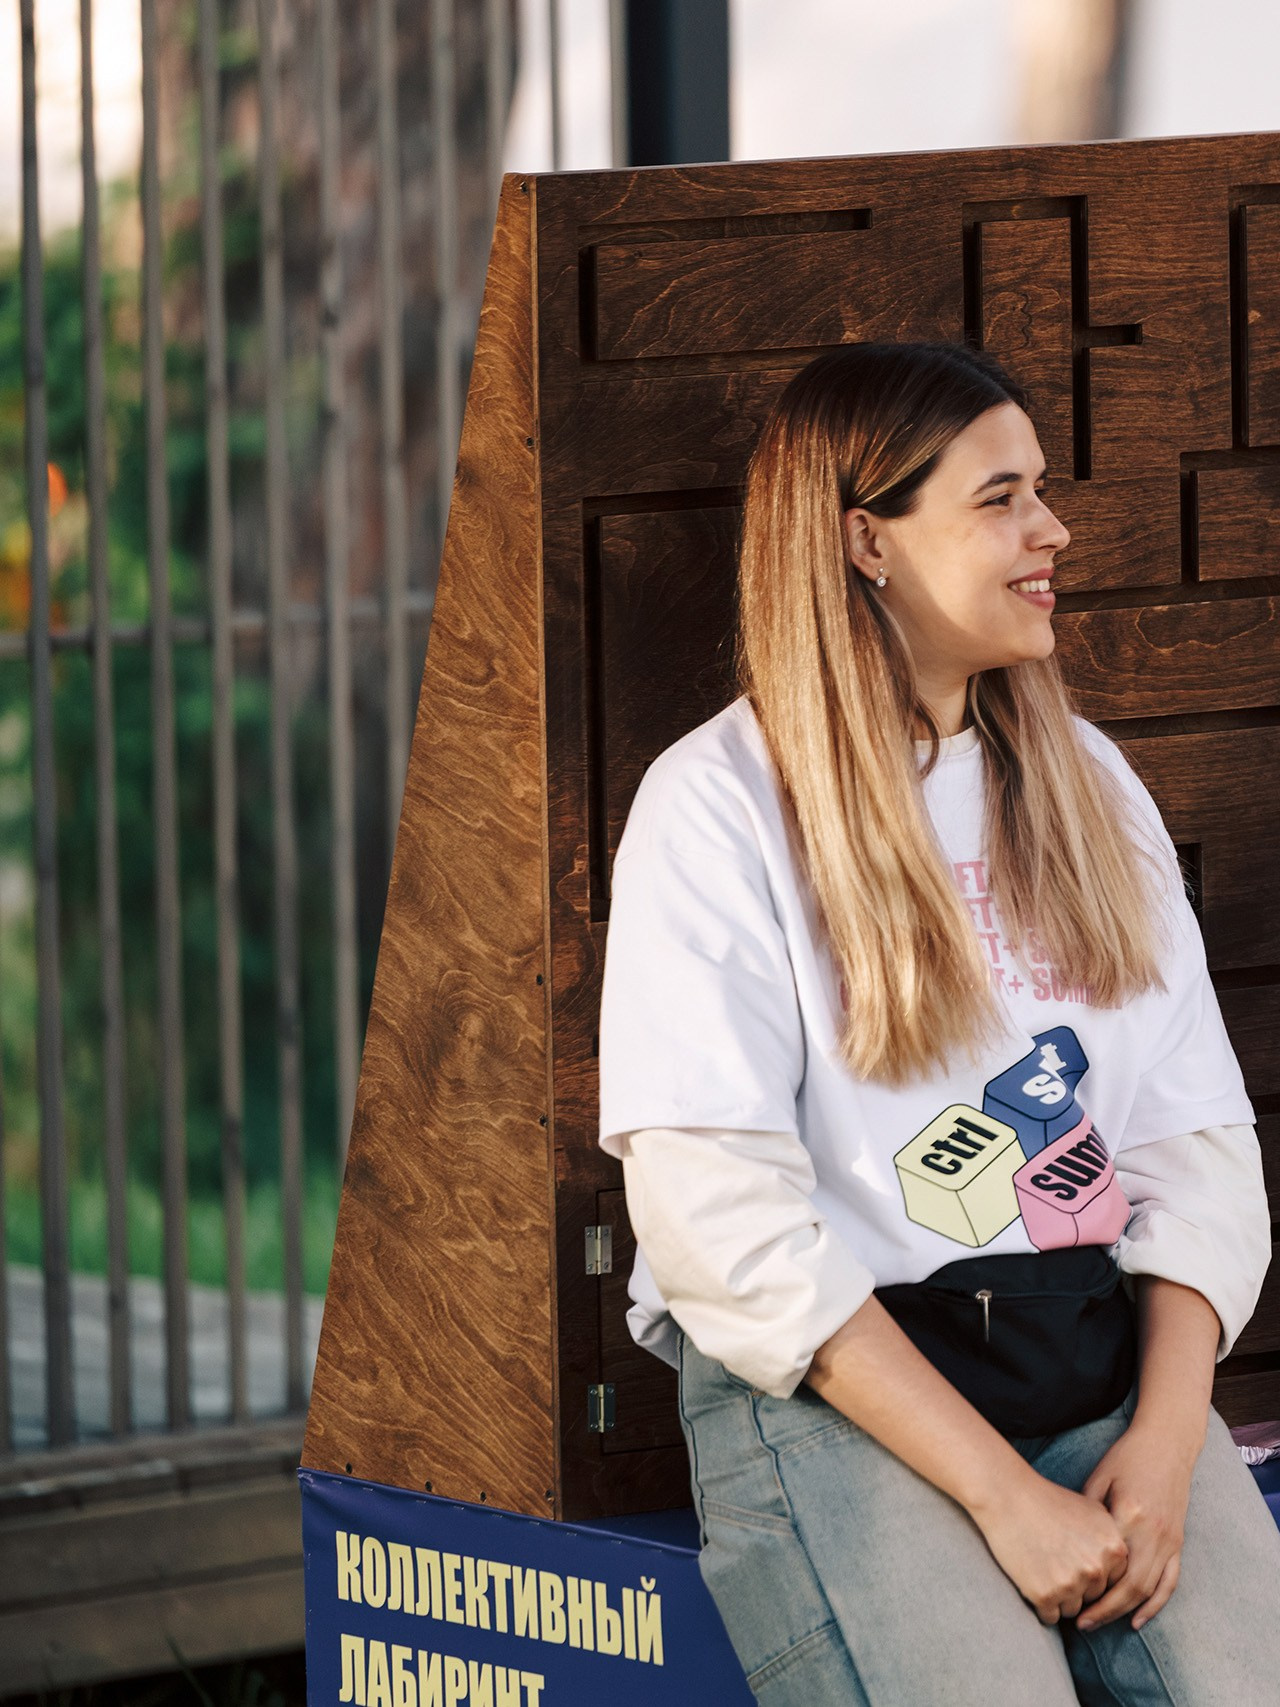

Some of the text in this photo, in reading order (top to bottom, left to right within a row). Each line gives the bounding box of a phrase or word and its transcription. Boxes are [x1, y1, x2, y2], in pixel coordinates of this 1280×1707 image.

[920, 1116, 999, 1175] ctrl
[1030, 1122, 1110, 1201] sum
[336, 1530, 664, 1666] КОЛЛЕКТИВНЫЙ
[339, 1633, 545, 1707] ЛАБИРИНТ
